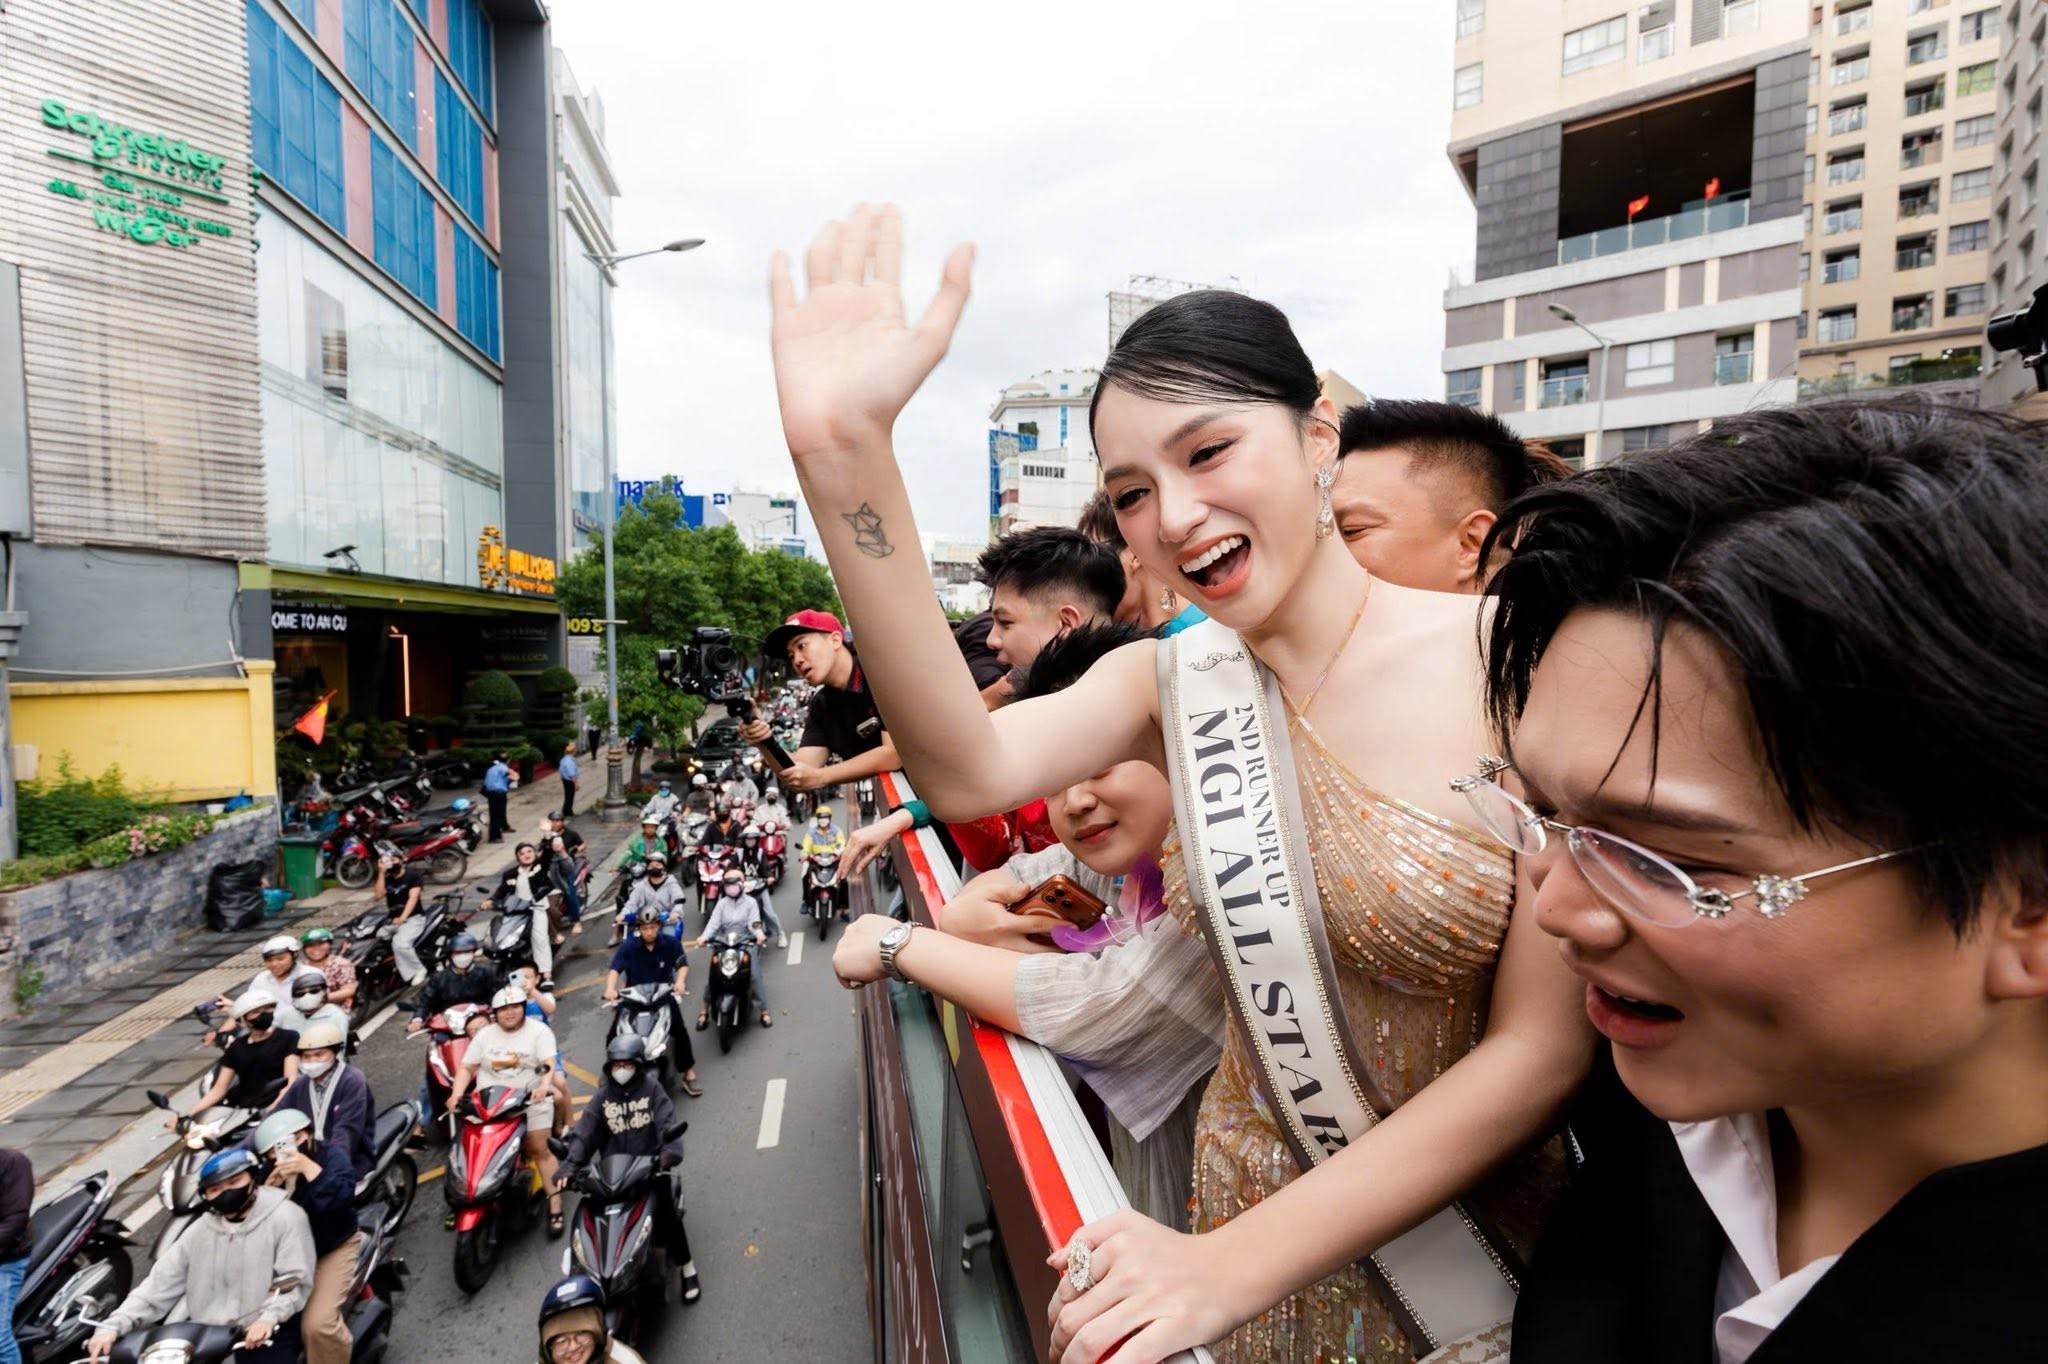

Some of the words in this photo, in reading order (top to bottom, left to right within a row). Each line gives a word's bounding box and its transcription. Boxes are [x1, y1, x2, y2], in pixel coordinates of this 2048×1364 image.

[41, 98, 225, 174] Schneider
[127, 147, 224, 191] Electric
[1234, 703, 1261, 750] 2ND
[1188, 708, 1246, 829] MGI
[1246, 756, 1281, 866] RUNNER
[1210, 847, 1274, 966] ALL
[1265, 871, 1290, 908] UP
